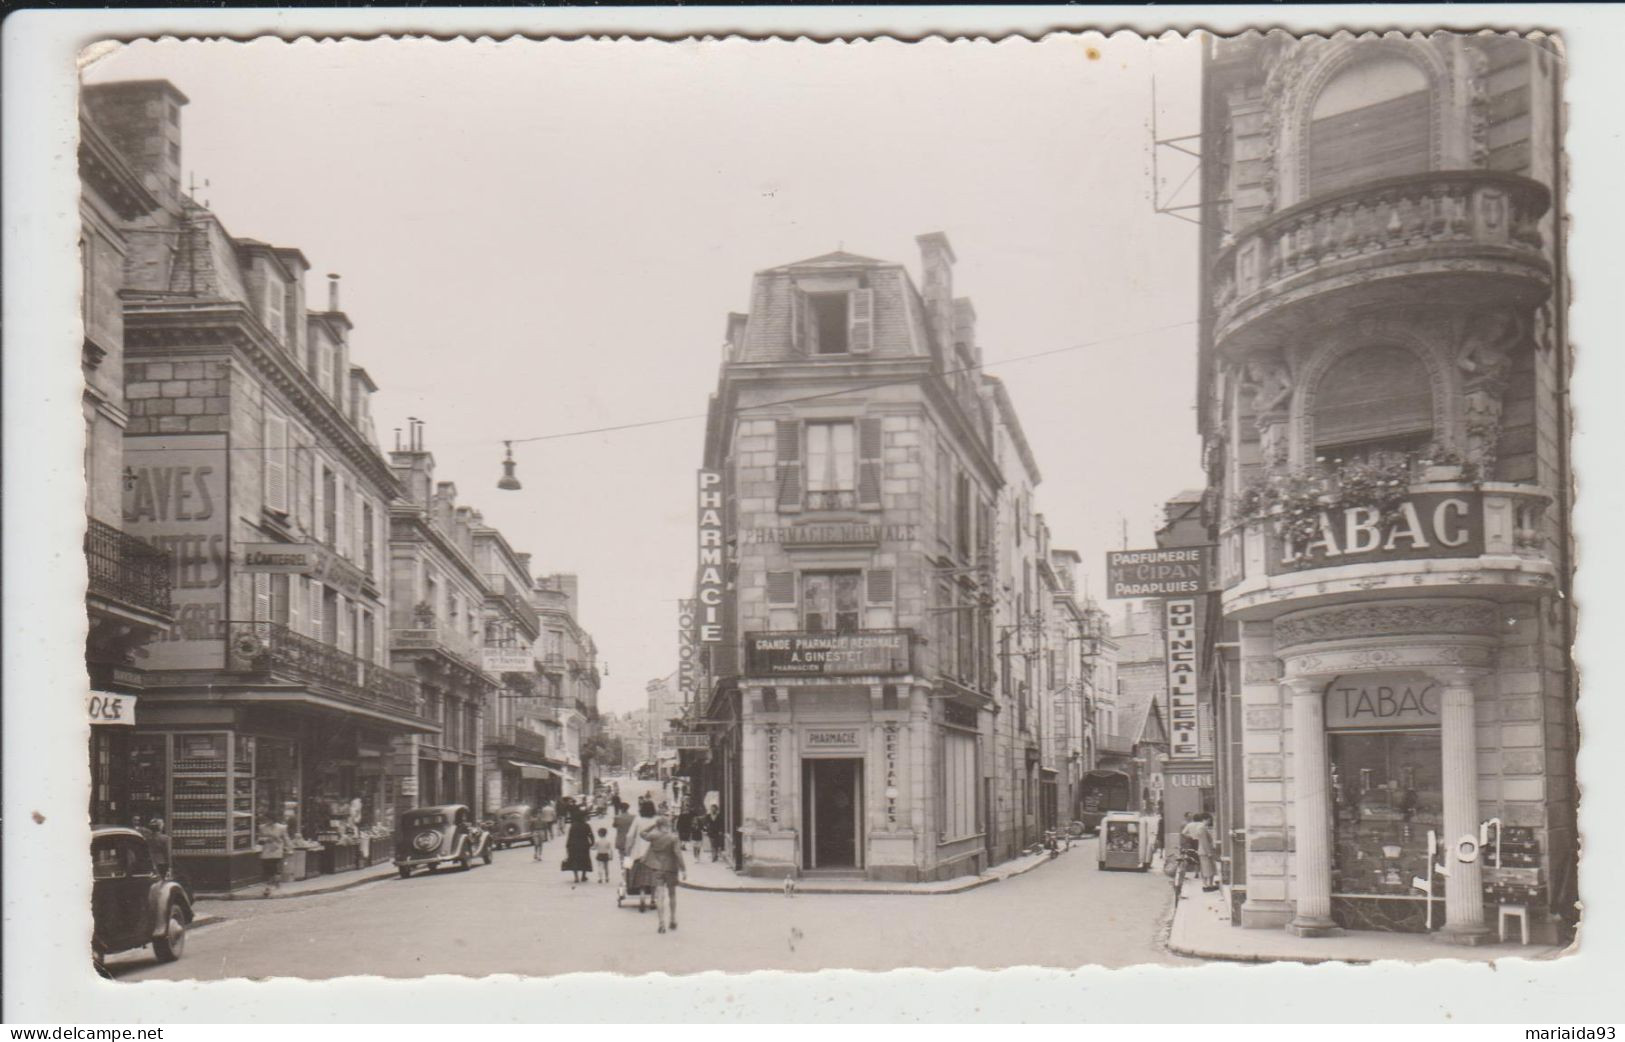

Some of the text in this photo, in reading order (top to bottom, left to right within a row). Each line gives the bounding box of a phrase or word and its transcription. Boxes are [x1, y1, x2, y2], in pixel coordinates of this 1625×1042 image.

[745, 525, 916, 544] PHARMACIE NORMALE
[700, 473, 722, 642] PHARMACIE
[1112, 549, 1200, 566] PARFUMERIE
[1136, 564, 1201, 581] CIPAN
[1115, 580, 1198, 595] PARAPLUIES
[756, 639, 790, 650] GRANDE
[796, 637, 848, 650] PHARMACIE
[677, 599, 696, 721] MONOPRIX
[805, 651, 862, 662] GINESTET
[1170, 604, 1195, 754] QUINCAILLERIE
[1335, 682, 1437, 718] TABAC
[810, 732, 856, 743] PHARMACIE
[886, 726, 896, 823] SPECIALTES
